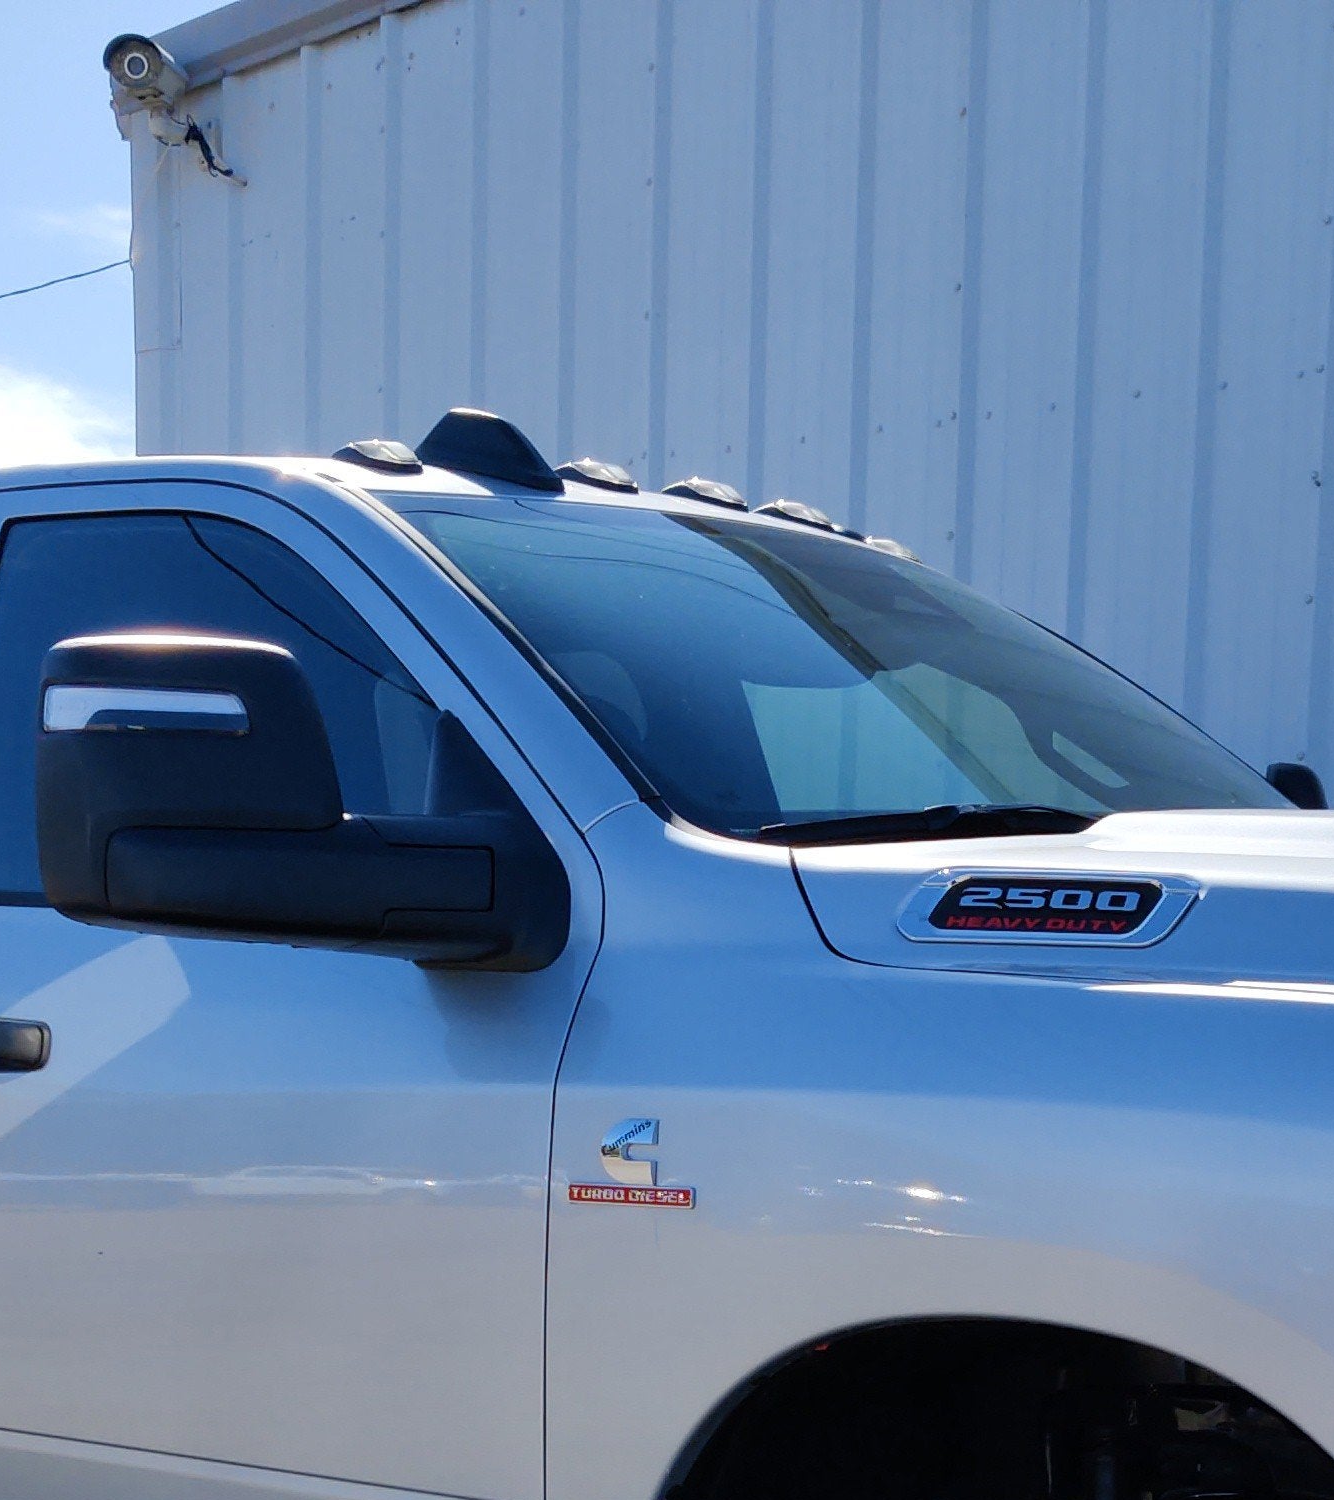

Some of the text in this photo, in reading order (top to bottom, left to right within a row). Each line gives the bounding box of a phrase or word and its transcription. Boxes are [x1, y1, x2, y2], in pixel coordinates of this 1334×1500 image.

[959, 886, 1141, 912] 2500
[945, 915, 1128, 932] HEAVY DUTY
[601, 1119, 652, 1156] Cummins
[571, 1186, 690, 1205] TURBO DIESEL
